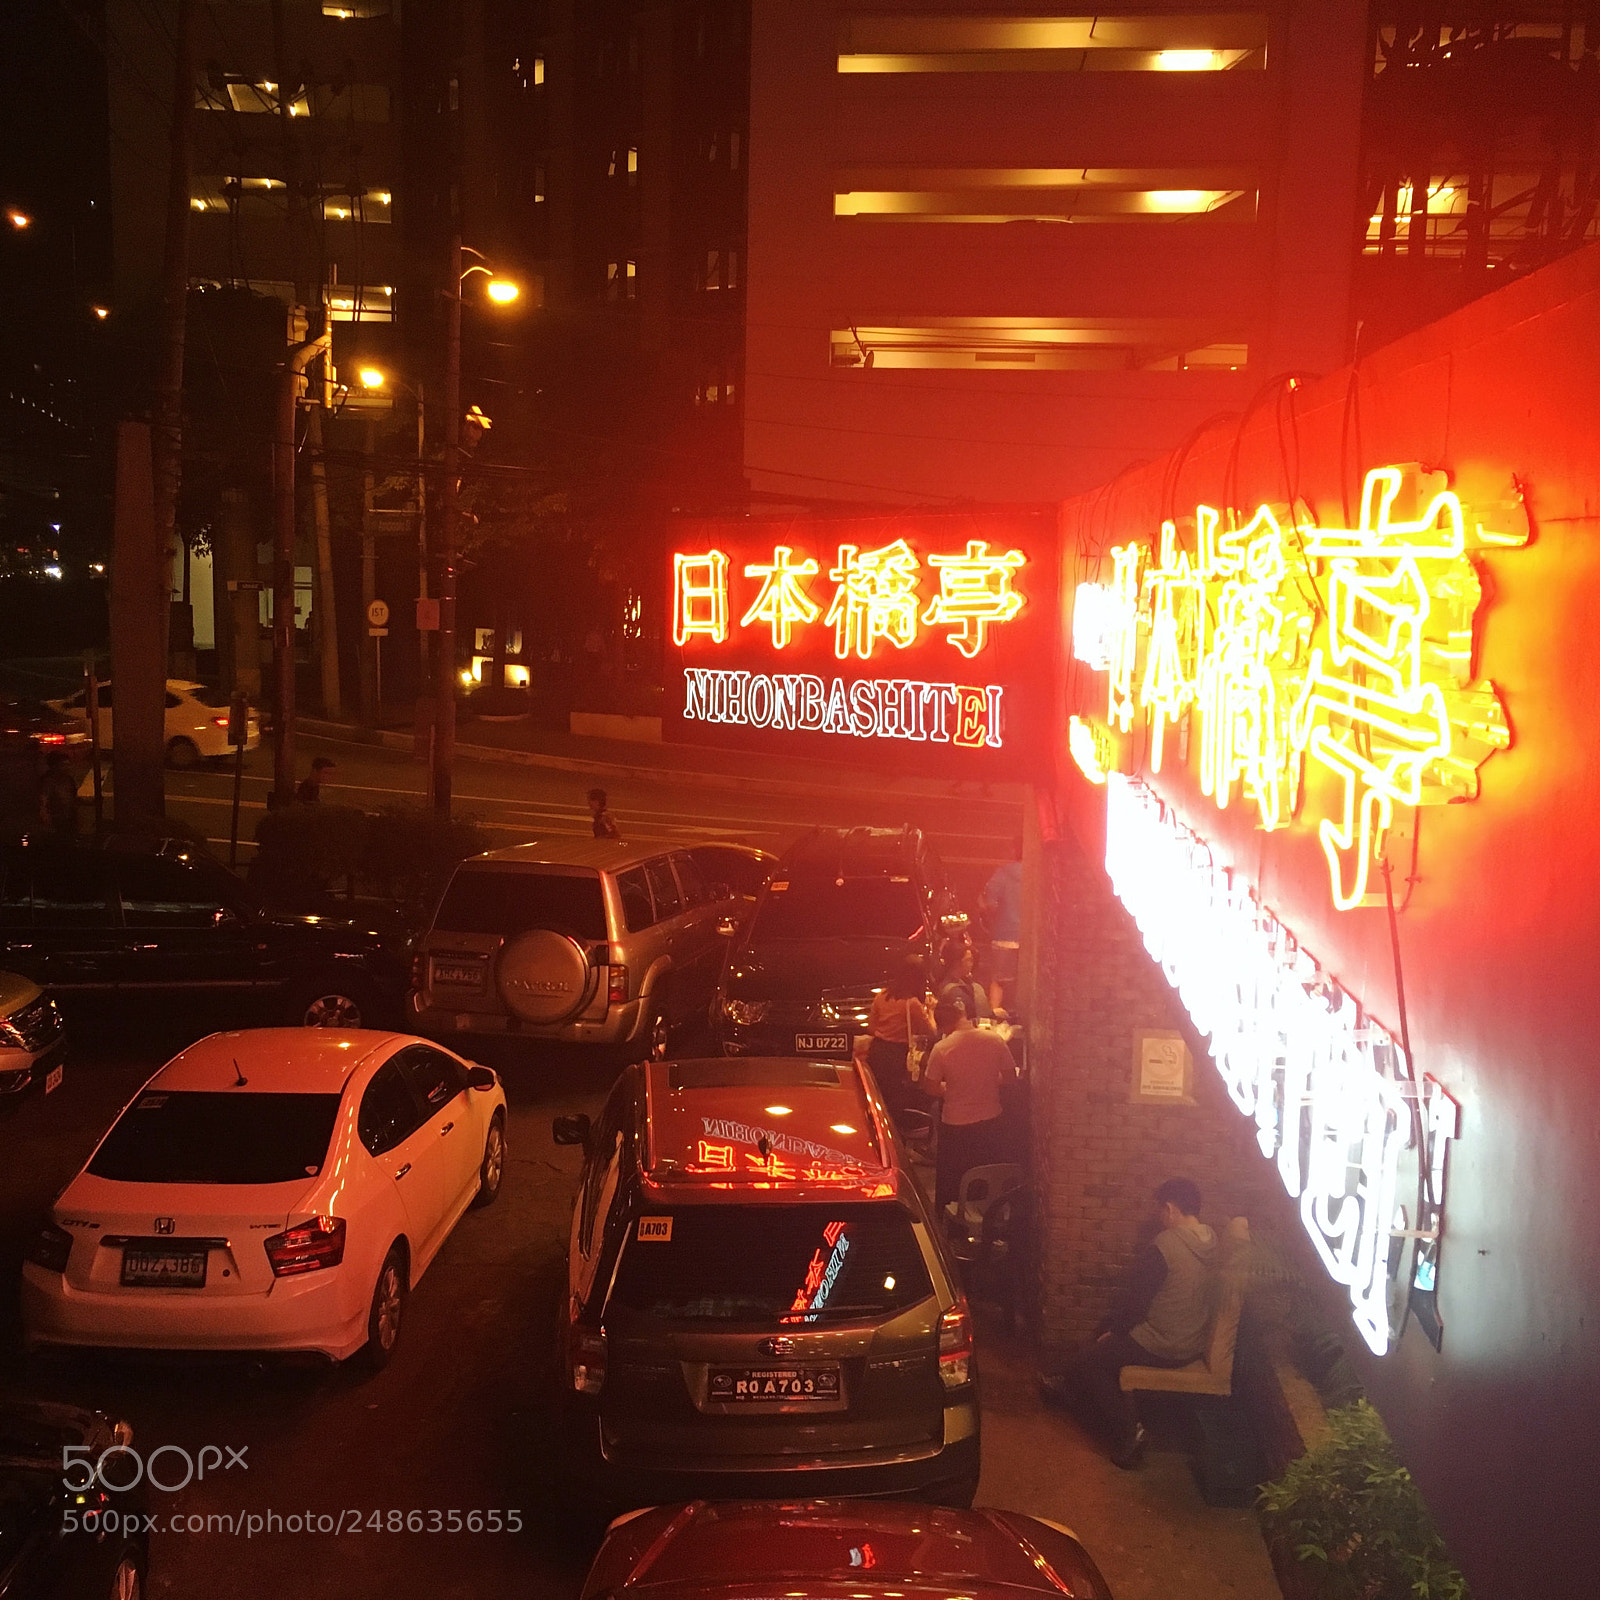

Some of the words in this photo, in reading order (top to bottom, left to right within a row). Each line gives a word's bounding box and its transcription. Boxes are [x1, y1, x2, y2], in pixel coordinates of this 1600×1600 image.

[673, 538, 1027, 660] 日本橋亭
[683, 667, 1004, 749] NIHONBASHITEI
[798, 1037, 813, 1048] NJ
[816, 1037, 845, 1048] 0722
[645, 1222, 668, 1236] A703
[751, 1371, 798, 1379] REGISTERED
[763, 1379, 815, 1394] A703
